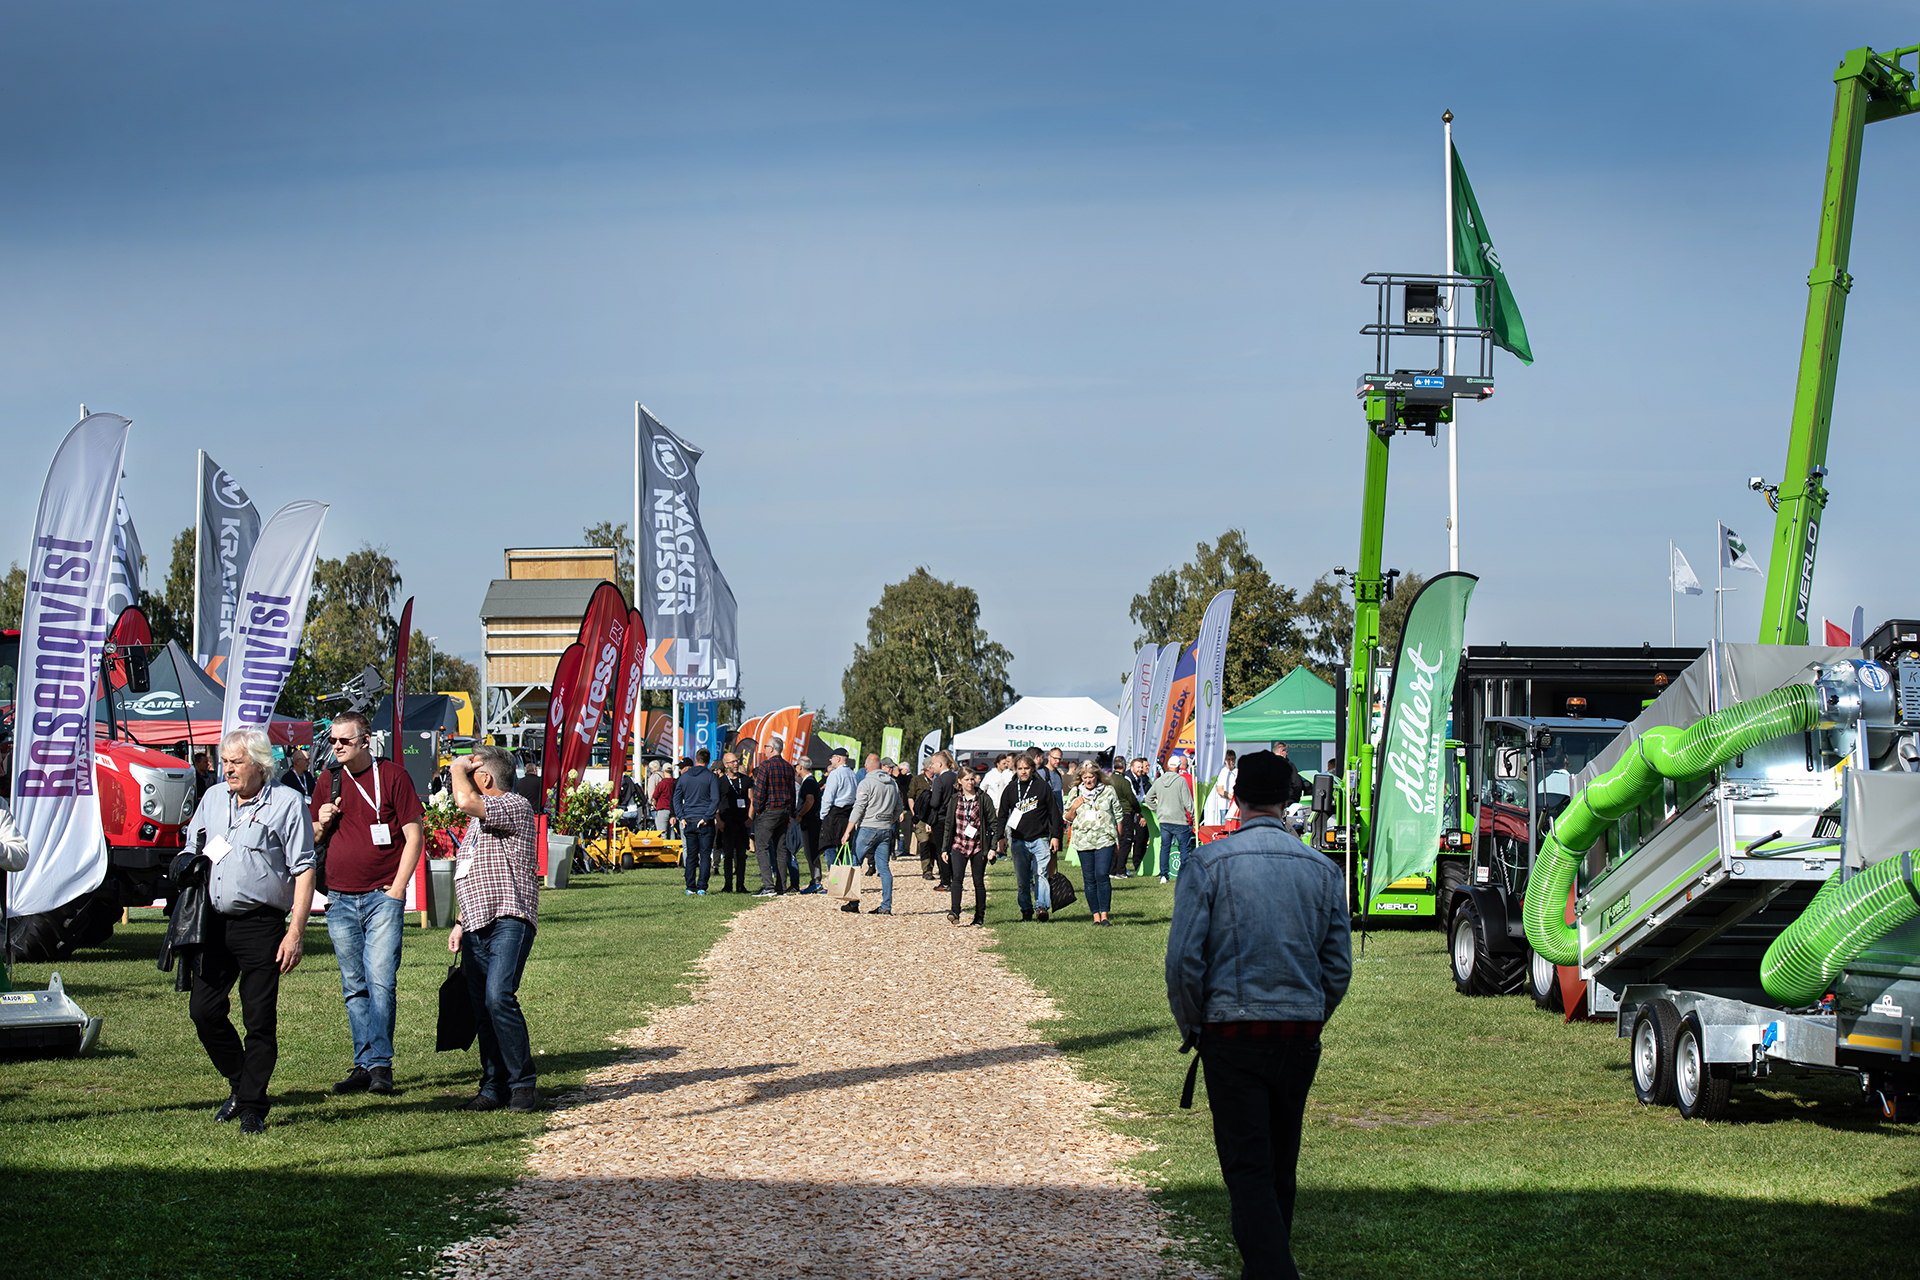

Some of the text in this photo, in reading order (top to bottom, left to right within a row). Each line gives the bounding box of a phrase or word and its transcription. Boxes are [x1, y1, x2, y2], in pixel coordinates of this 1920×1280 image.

[219, 517, 241, 642] KRAMER
[654, 488, 677, 616] NEUSON
[675, 491, 696, 615] WACKER
[1796, 520, 1818, 621] MERLO
[16, 534, 102, 798] Rosenqvist
[238, 591, 293, 732] enqvist
[574, 642, 617, 744] Kress
[642, 676, 711, 687] KH-MASKIN
[678, 689, 737, 700] KH-MASKIN
[1004, 723, 1090, 733] Belrobotics
[1008, 739, 1105, 749] Tidab www.tidab.se
[1160, 688, 1191, 765] Dipperfox
[1386, 642, 1443, 814] Hüllert
[1422, 732, 1441, 816] Maskin
